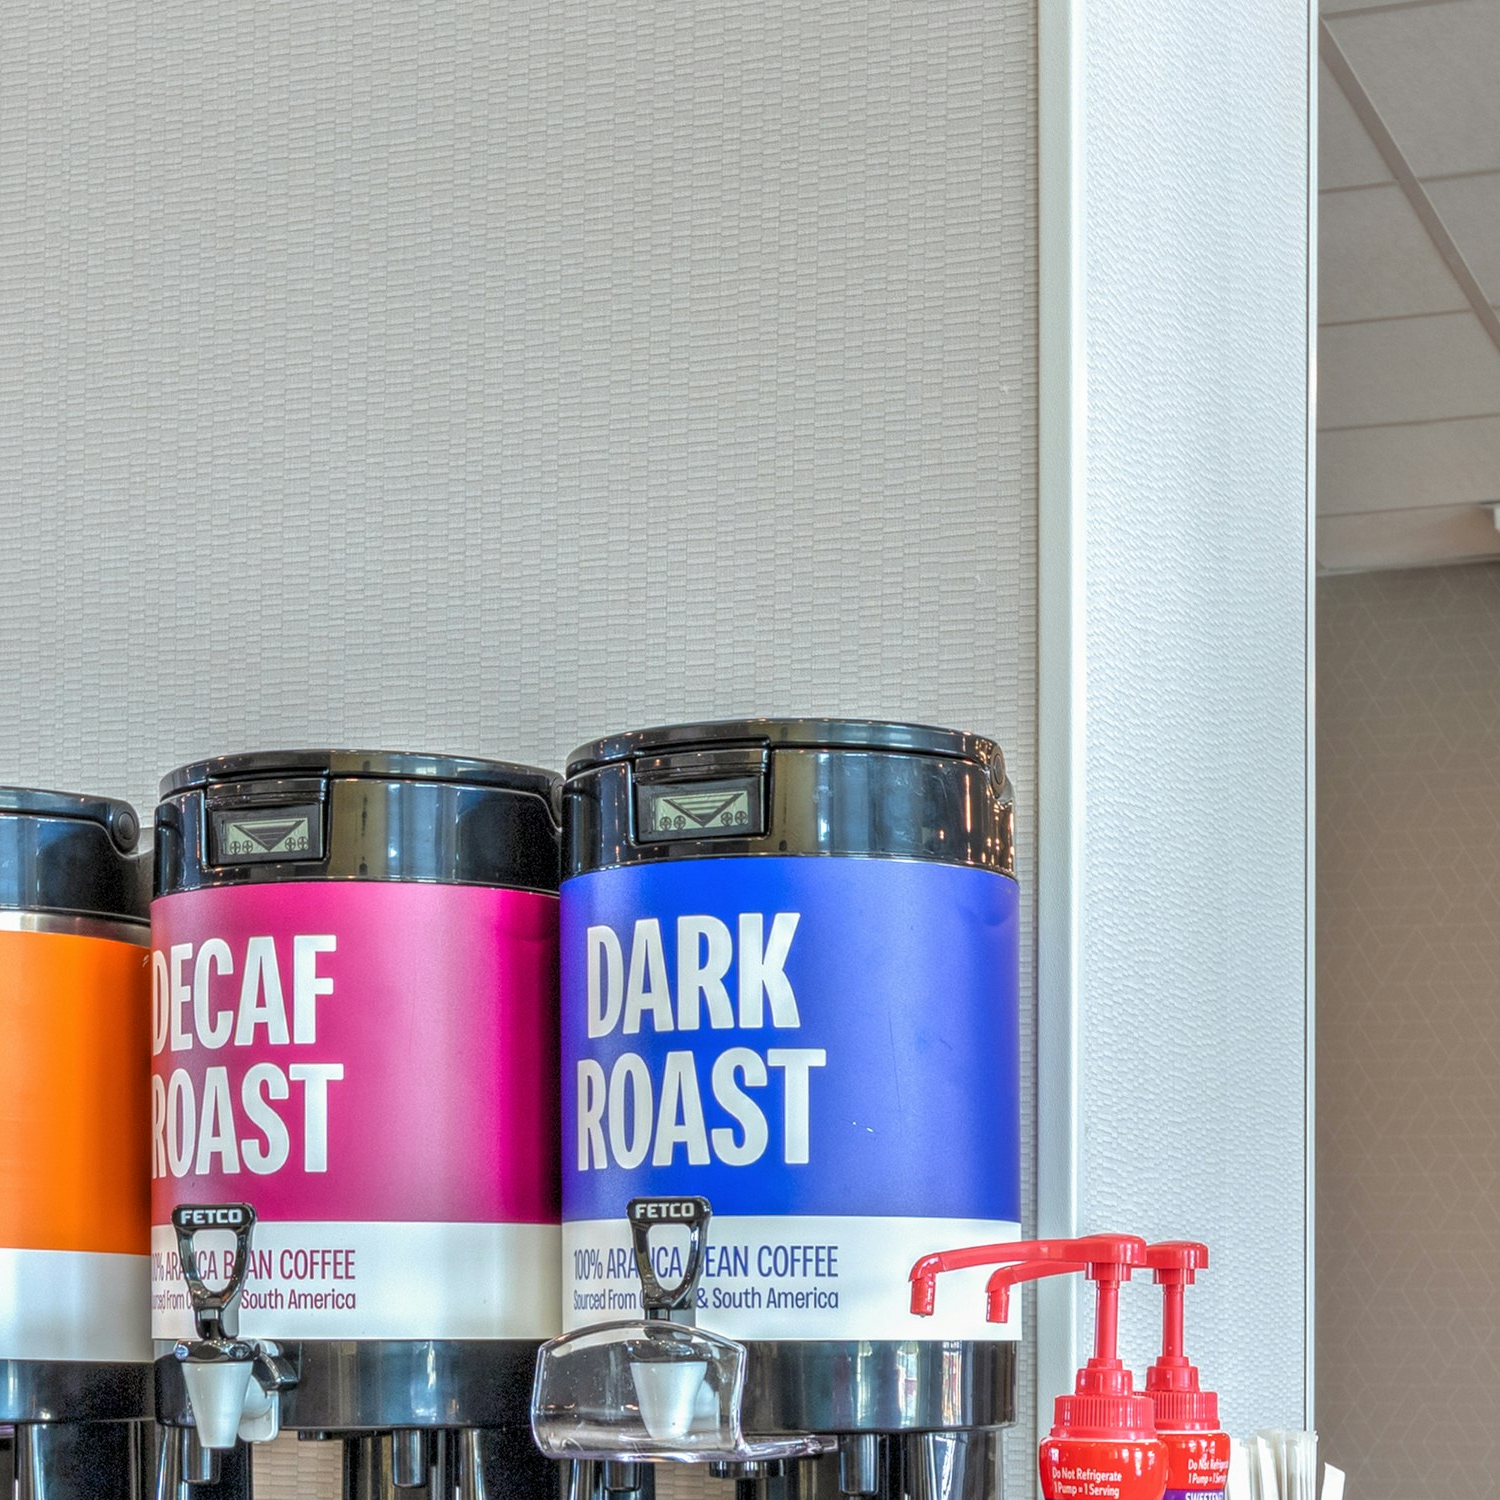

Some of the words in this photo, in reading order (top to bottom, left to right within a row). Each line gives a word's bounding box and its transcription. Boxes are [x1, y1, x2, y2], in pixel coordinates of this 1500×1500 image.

[586, 911, 801, 1040] DARK
[152, 934, 338, 1058] DECAF
[152, 1061, 344, 1181] ROAST
[576, 1046, 827, 1172] ROAST
[180, 1208, 243, 1225] FETCO
[634, 1202, 695, 1219] FETCO
[223, 1249, 272, 1280] BAN
[280, 1249, 356, 1280] COFFEE
[573, 1248, 603, 1281] 100%
[606, 1246, 683, 1280] ARAICA
[700, 1245, 749, 1278] EAN
[756, 1245, 839, 1278] COFFEE
[241, 1288, 284, 1310] South
[288, 1288, 356, 1310] America
[573, 1289, 607, 1311] Sourced
[608, 1290, 636, 1311] From
[712, 1287, 761, 1309] South
[766, 1286, 839, 1309] America
[1052, 1466, 1062, 1480] Do
[1062, 1467, 1076, 1481] Not
[1076, 1467, 1123, 1483] Refrigerate
[1058, 1482, 1077, 1497] Pump
[1089, 1483, 1120, 1499] Serving
